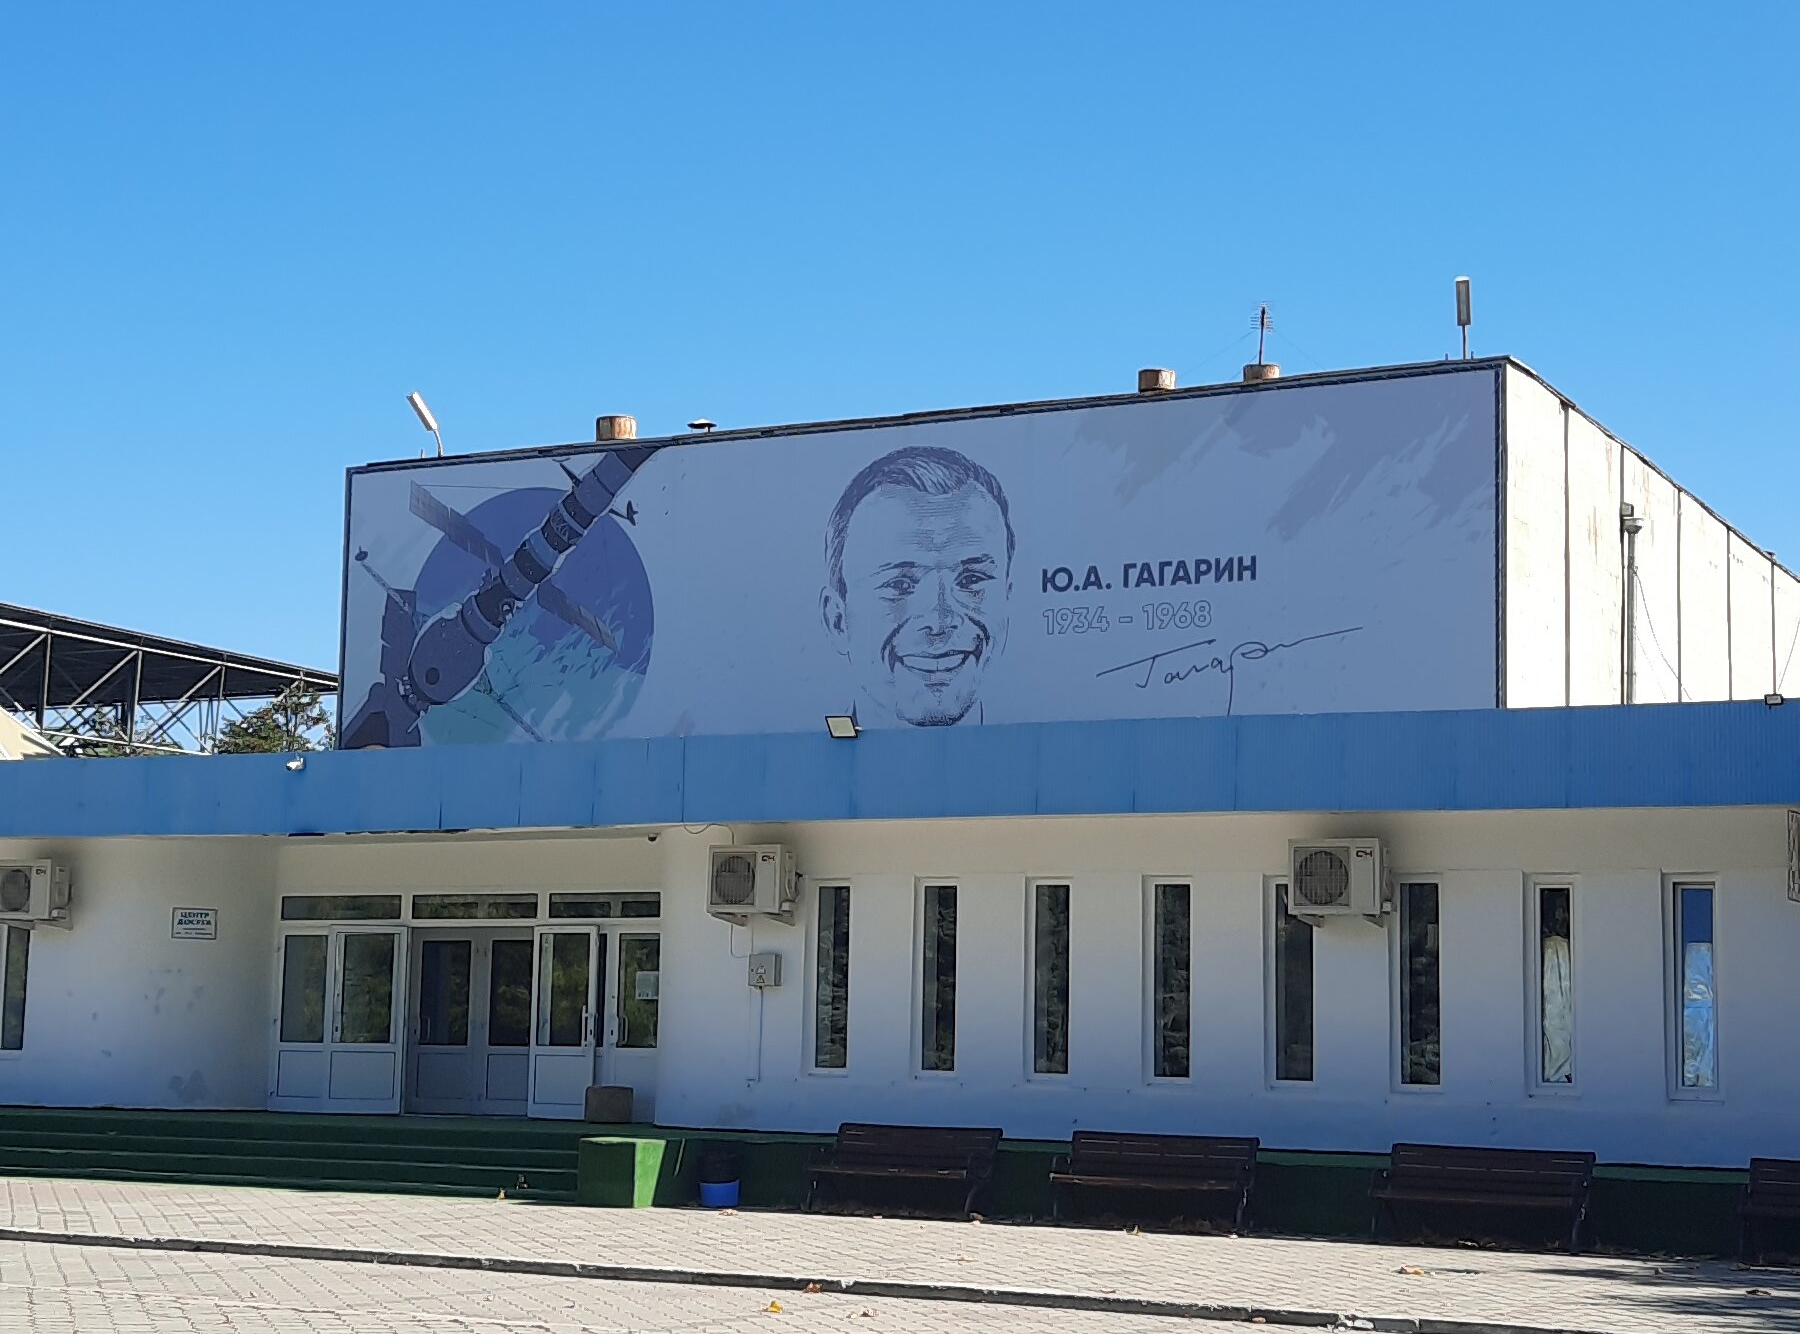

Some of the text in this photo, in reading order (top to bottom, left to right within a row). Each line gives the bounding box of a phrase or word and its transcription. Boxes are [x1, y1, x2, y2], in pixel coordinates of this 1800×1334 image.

[1041, 554, 1257, 594] Ю.А. ГАГАРИН
[1042, 605, 1110, 635] 1934
[1142, 599, 1212, 630] 1968
